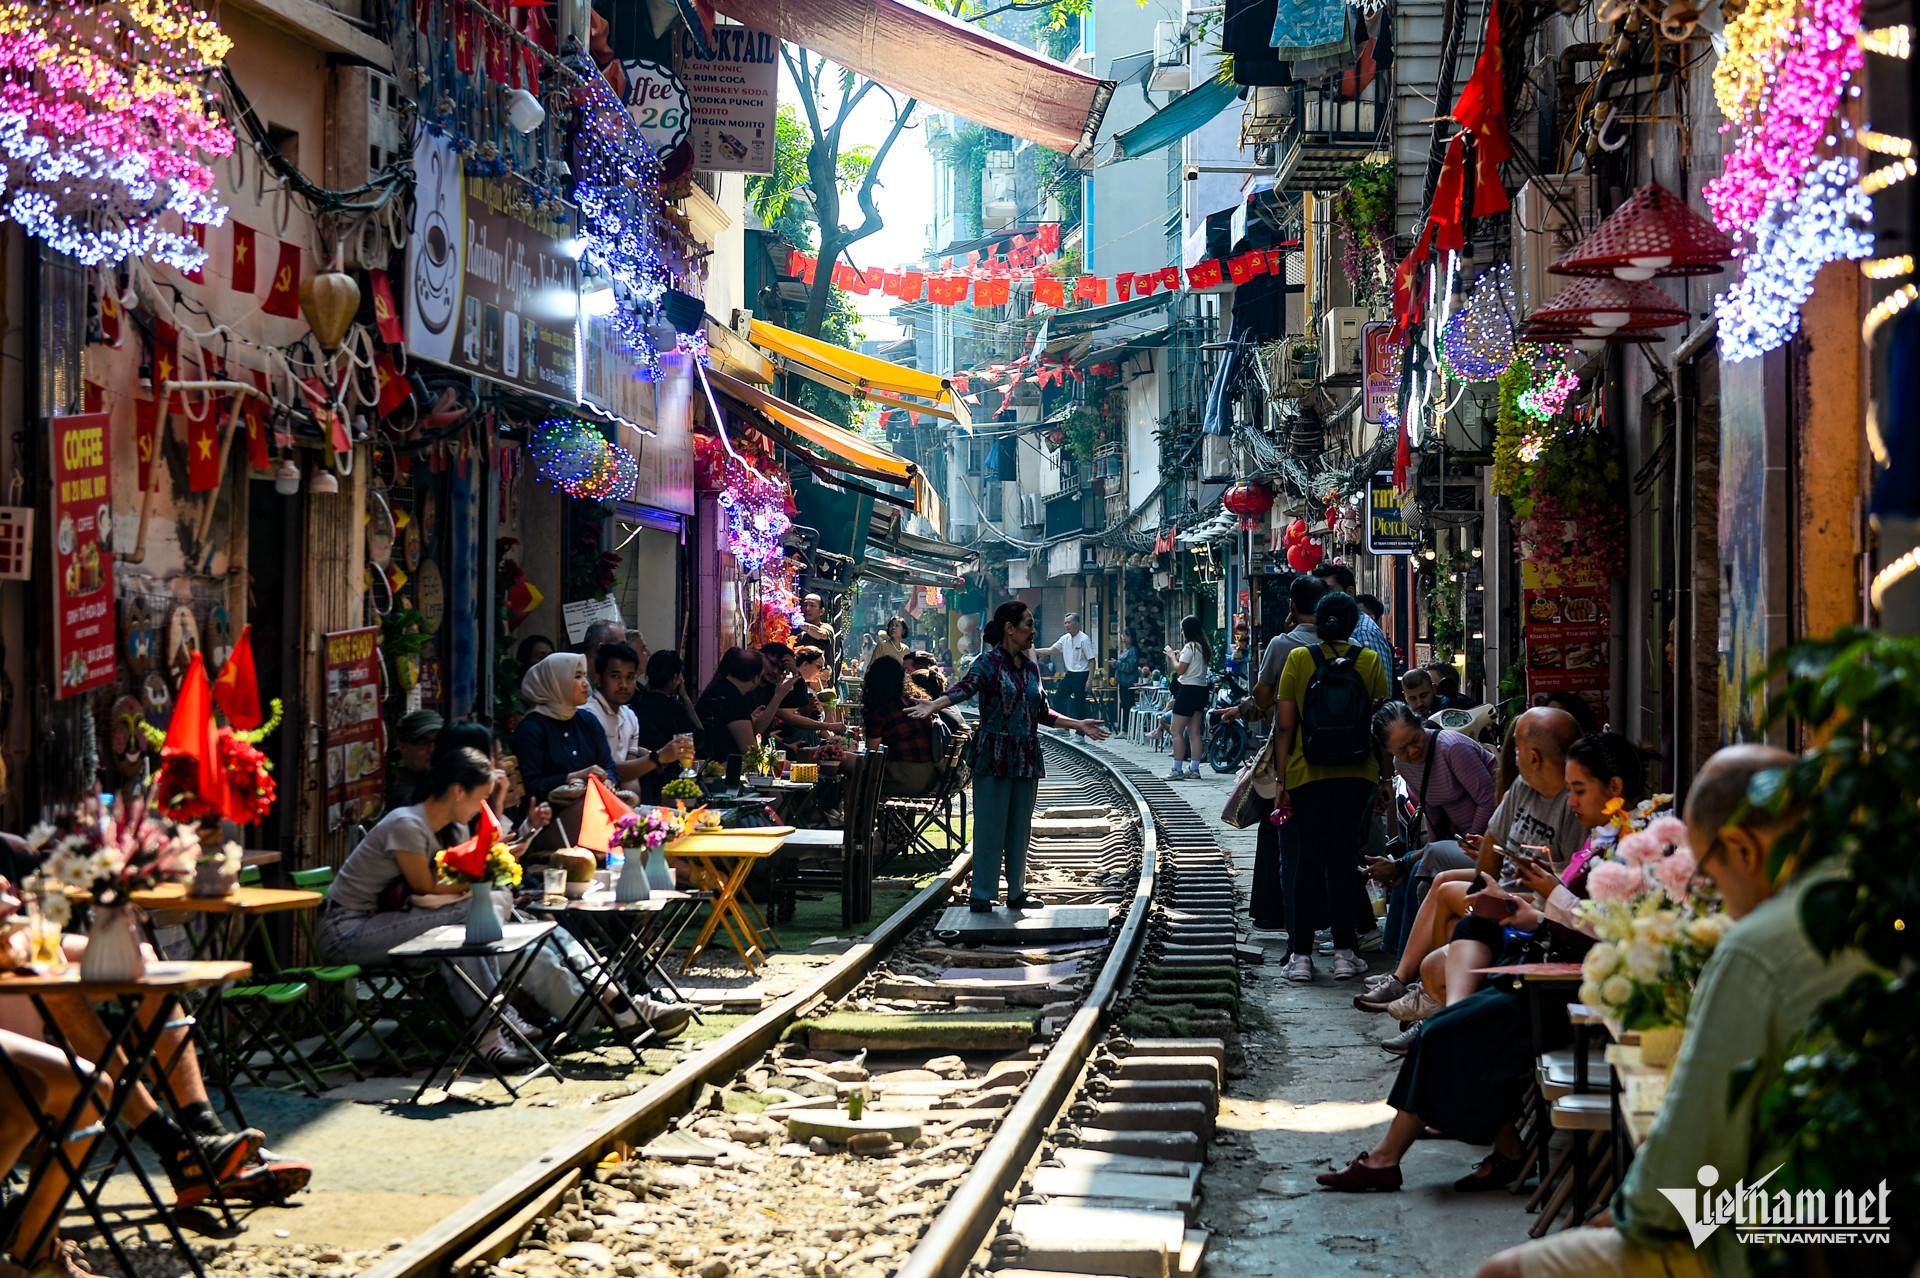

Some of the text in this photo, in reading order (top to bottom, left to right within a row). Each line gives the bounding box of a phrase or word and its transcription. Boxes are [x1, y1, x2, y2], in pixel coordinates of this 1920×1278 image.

[693, 63, 711, 72] GIN
[712, 64, 742, 73] TONIC
[683, 73, 746, 84] 2. RUM COCA
[628, 77, 674, 107] ffee
[693, 85, 739, 95] WHISKEY
[741, 88, 769, 97] SODA
[692, 95, 764, 107] VODKA PUNCH
[639, 107, 680, 129] 26
[692, 107, 729, 116] MOJITO
[691, 117, 765, 129] VIRGIN MOJITO
[465, 217, 503, 304] Railway
[504, 236, 532, 313] Coffee
[63, 427, 104, 470] COFFEE
[1372, 489, 1402, 508] TAT
[78, 515, 95, 532] COFFEE
